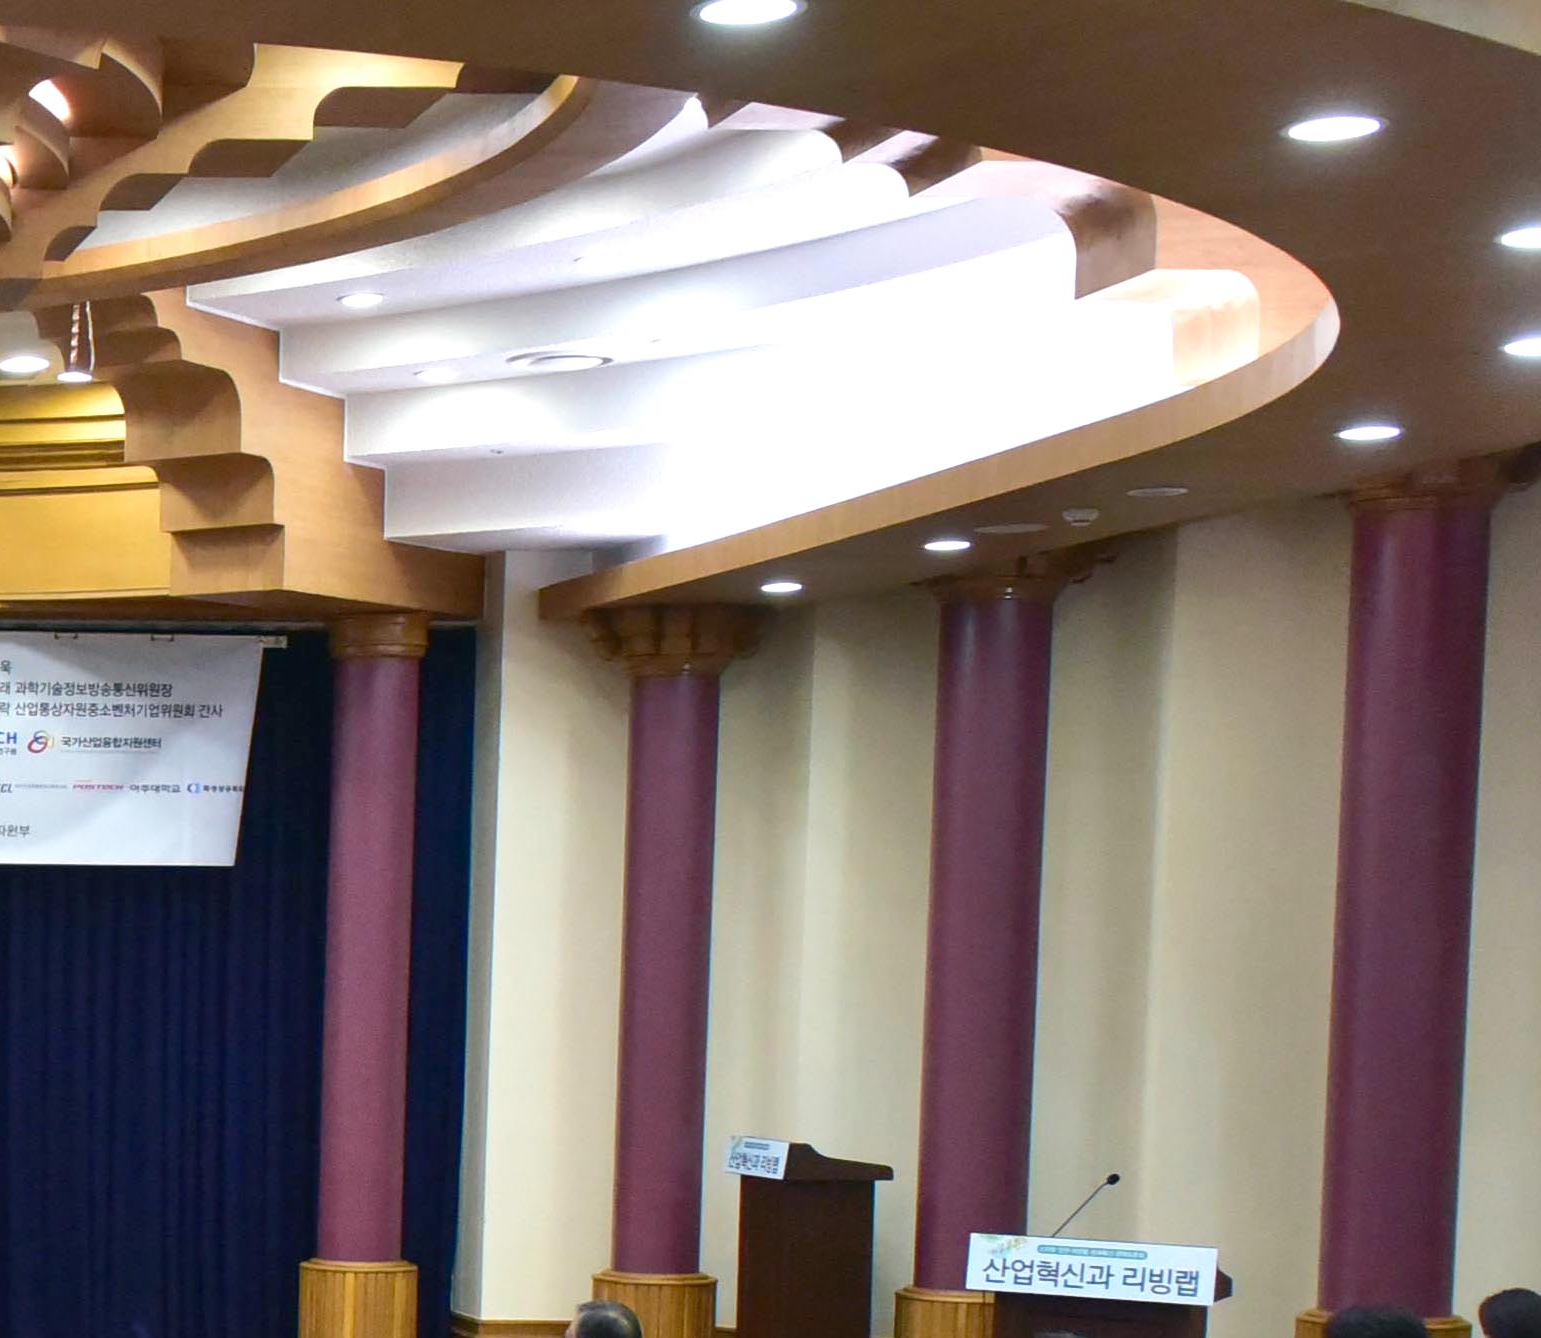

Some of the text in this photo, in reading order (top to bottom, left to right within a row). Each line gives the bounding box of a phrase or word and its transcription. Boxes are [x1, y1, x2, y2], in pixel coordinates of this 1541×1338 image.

[16, 681, 173, 698] 과학기술정보방송통신위원장
[15, 702, 195, 719] 산업통상자원중소벤처기업위원회
[198, 704, 223, 718] 간사
[982, 1257, 1200, 1298] 산업혁신과 리빙랩
